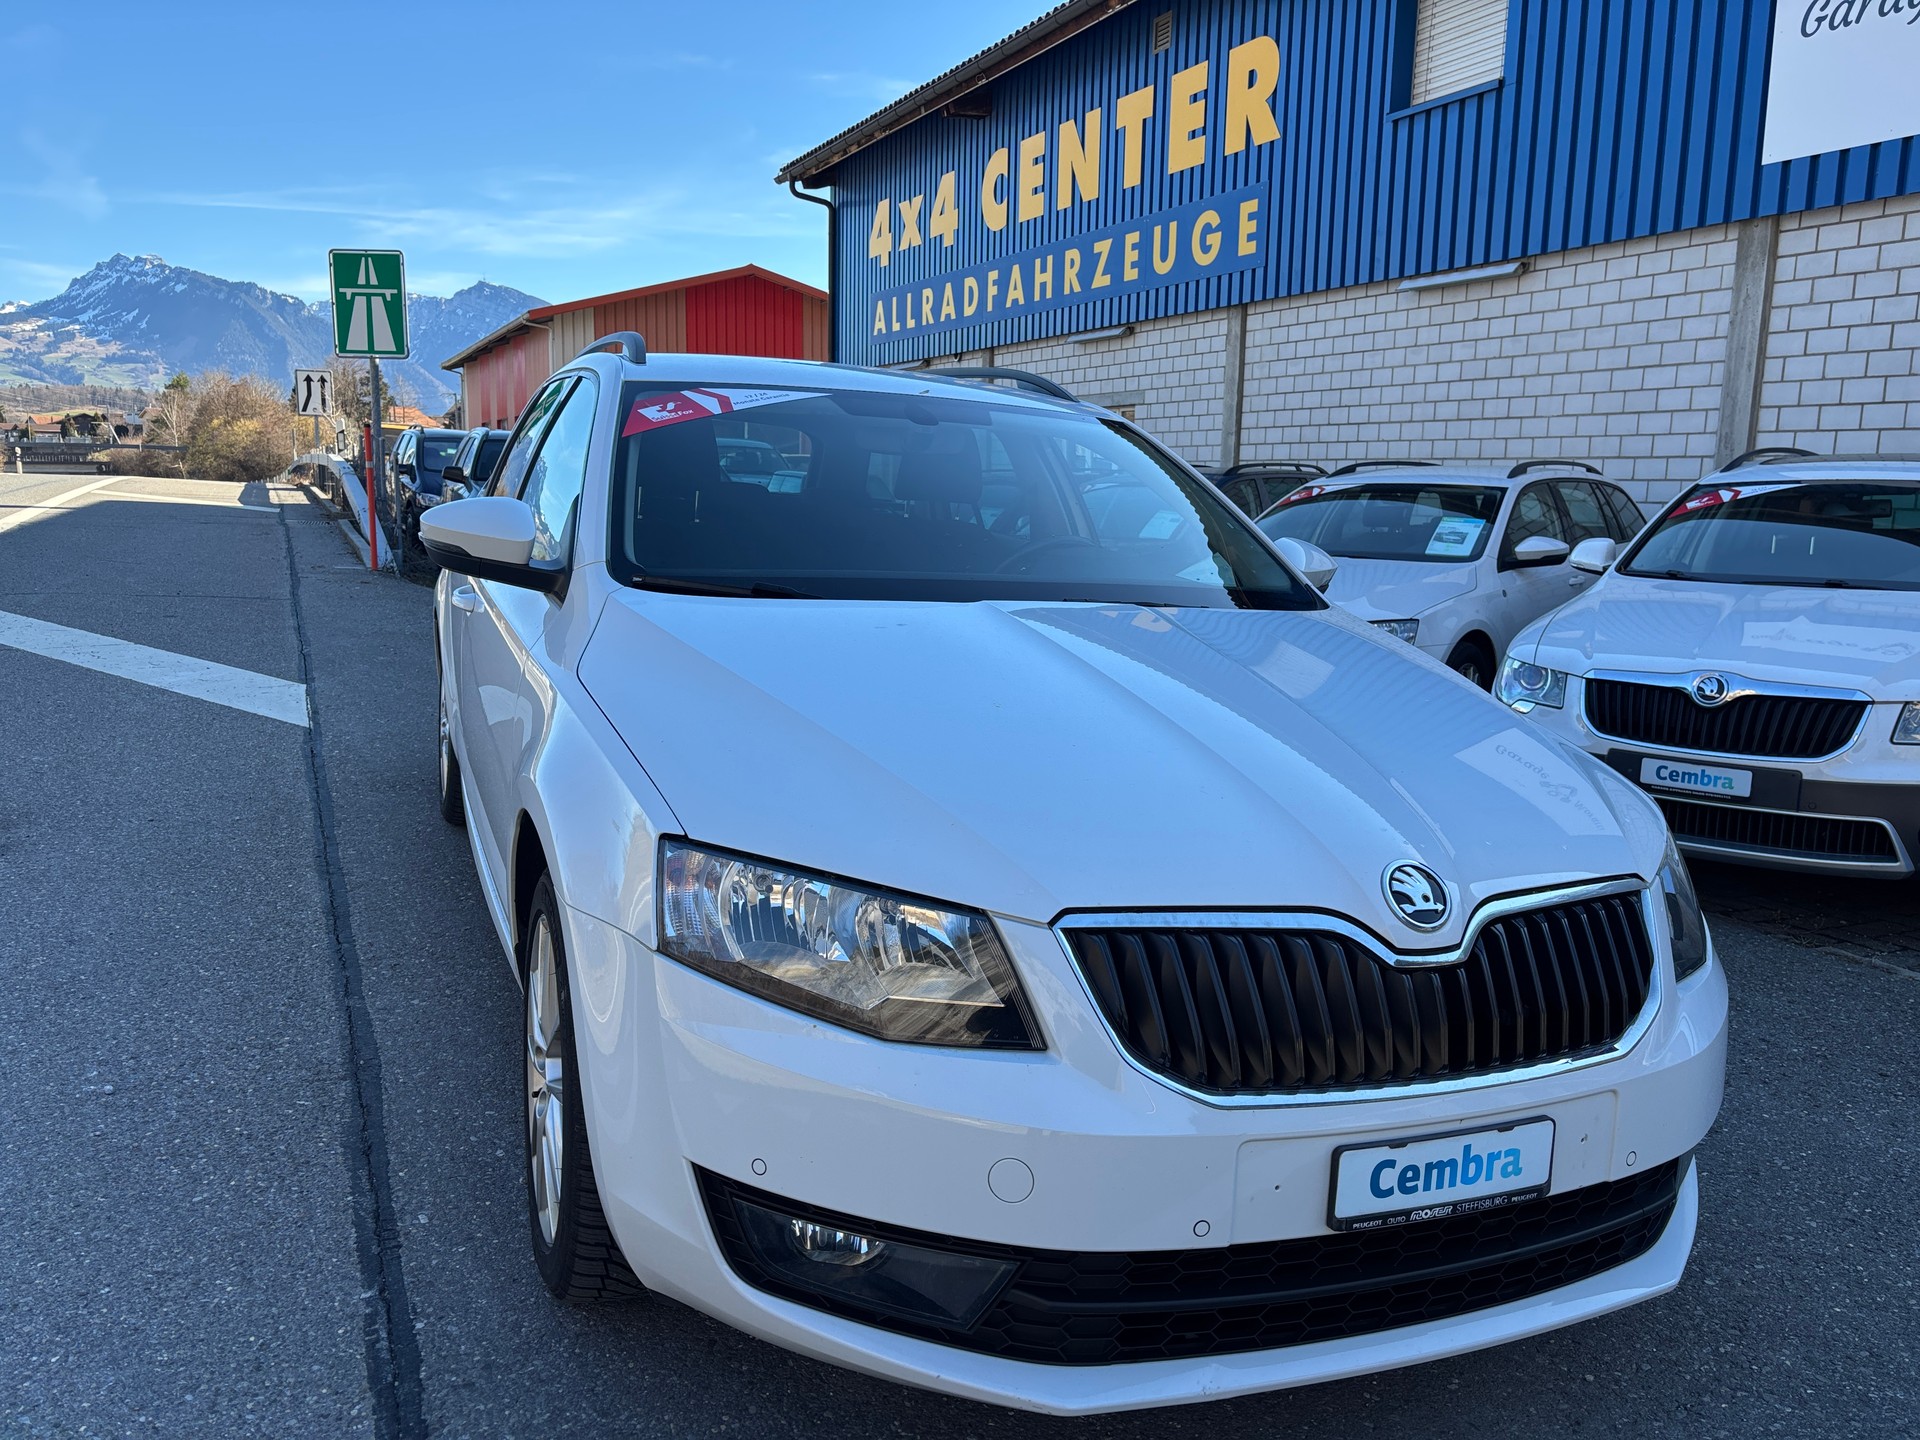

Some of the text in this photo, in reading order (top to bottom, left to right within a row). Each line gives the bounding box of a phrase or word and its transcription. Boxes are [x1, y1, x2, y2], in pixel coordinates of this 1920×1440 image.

[1800, 0, 1920, 38] Gara
[869, 35, 1282, 267] 4x4 CENTER
[872, 198, 1260, 336] ALLRADFAHRZEUGE
[1655, 764, 1735, 790] Cembra
[1370, 1144, 1522, 1199] Cembra
[1352, 1219, 1383, 1230] PEUGEOT
[1456, 1196, 1508, 1214] STEFFISBURG
[1511, 1192, 1538, 1203] PEUGEOT
